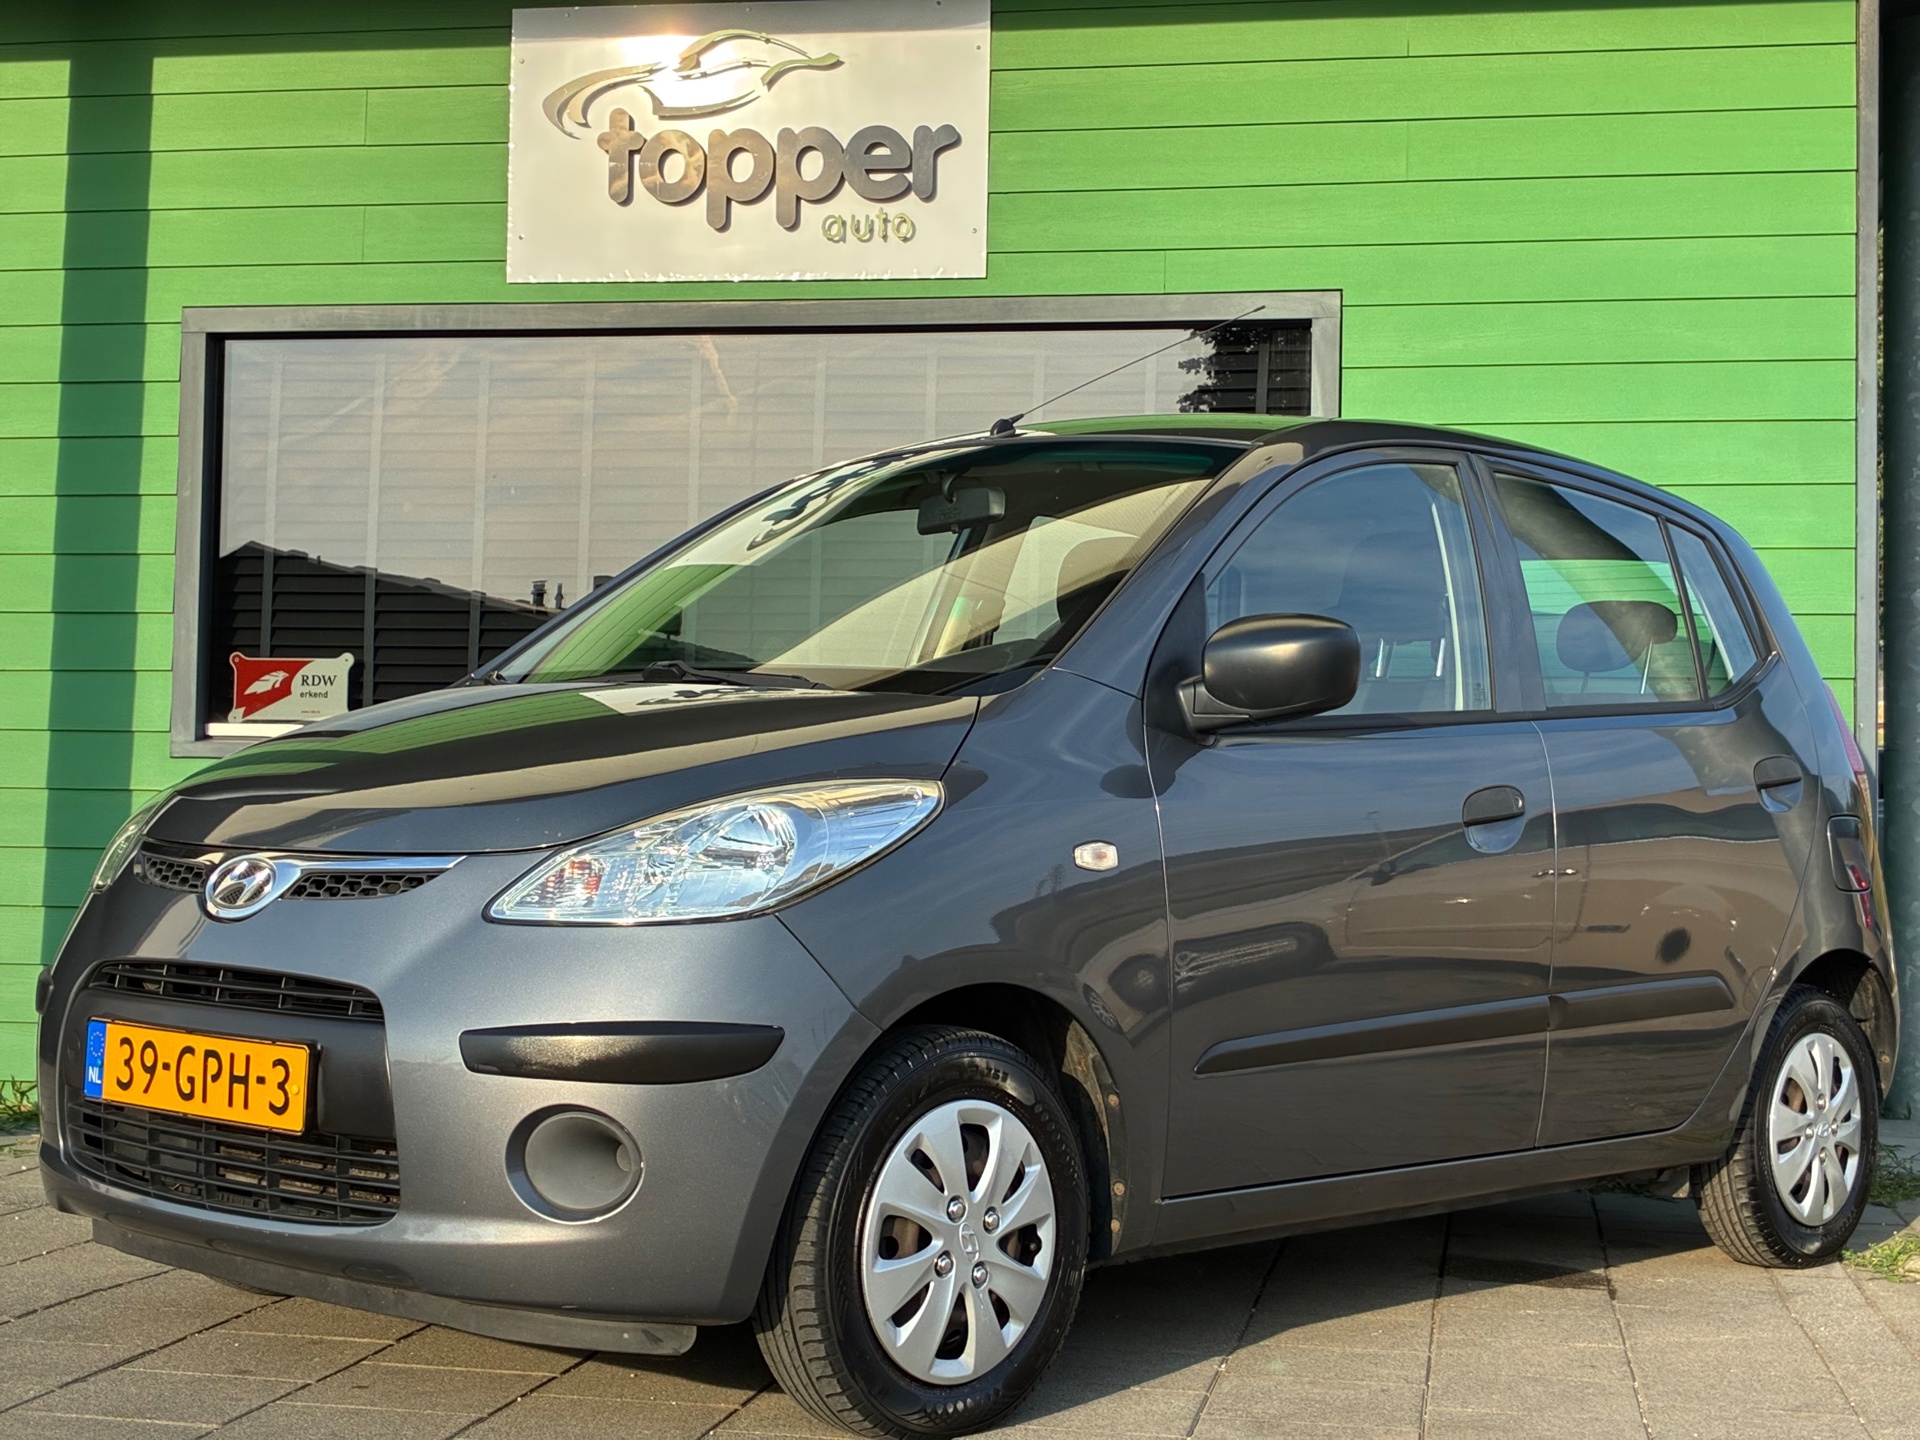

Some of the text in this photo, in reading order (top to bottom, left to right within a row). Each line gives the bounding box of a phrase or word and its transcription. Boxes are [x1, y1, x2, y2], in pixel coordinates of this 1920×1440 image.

[597, 107, 963, 231] topper
[822, 207, 915, 243] auto
[301, 674, 338, 687] RDW
[300, 690, 329, 699] erkend
[88, 1066, 102, 1085] NL
[116, 1036, 290, 1116] 39-GPH-3
